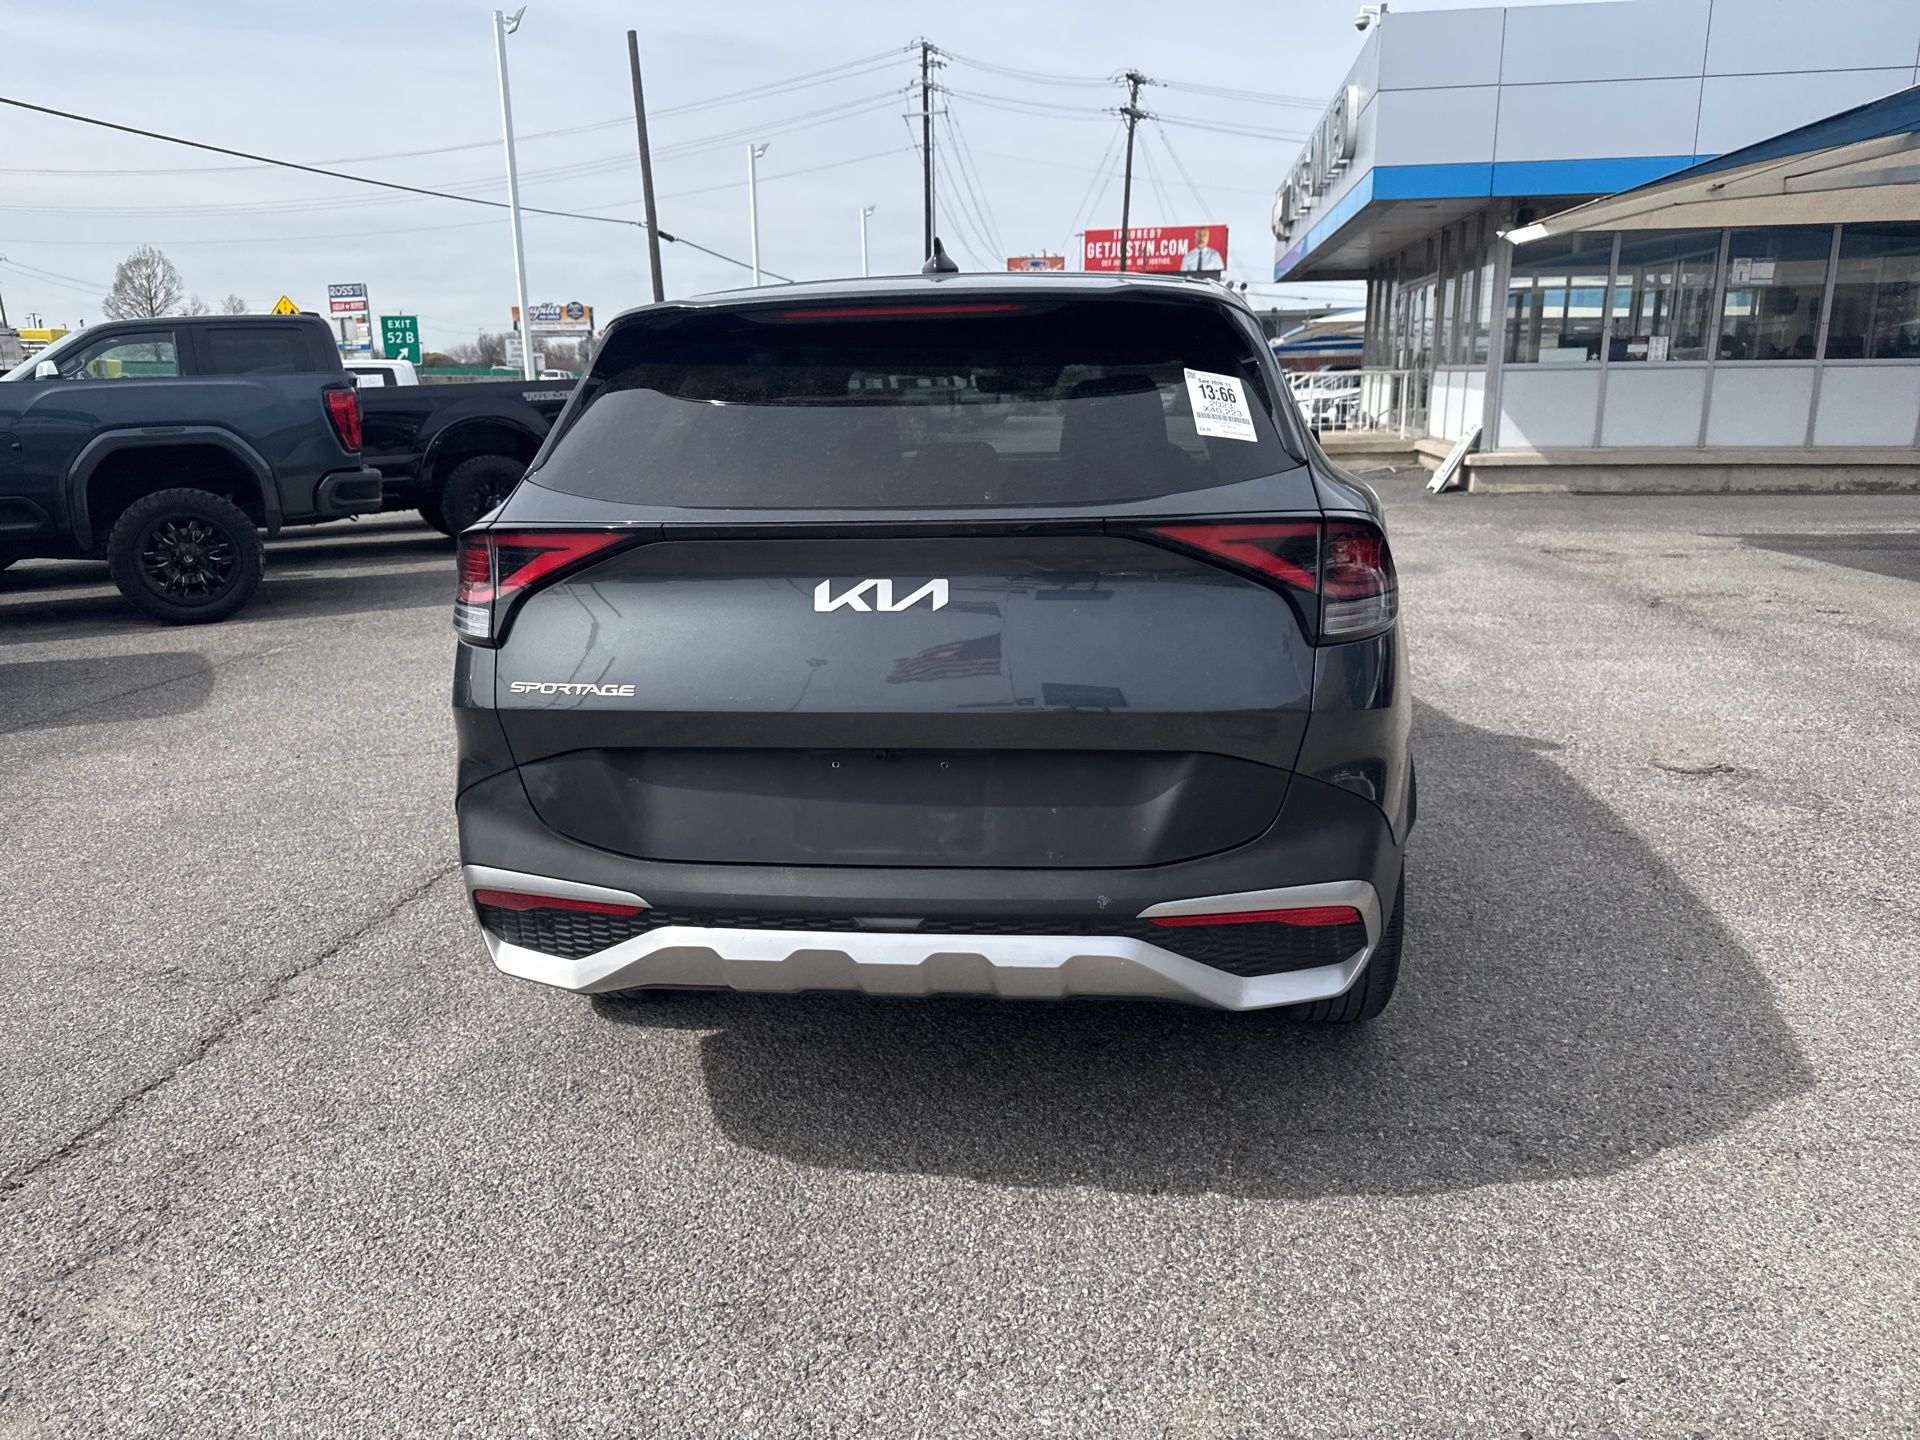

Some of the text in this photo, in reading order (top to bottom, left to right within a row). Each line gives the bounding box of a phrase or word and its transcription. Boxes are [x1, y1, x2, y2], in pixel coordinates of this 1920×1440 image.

[387, 319, 411, 329] EXIT
[387, 332, 415, 344] 52 B
[1198, 384, 1237, 404] 13:66
[1209, 400, 1234, 410] 2023
[814, 578, 949, 612] KIA
[509, 681, 635, 697] SPORTAGE
